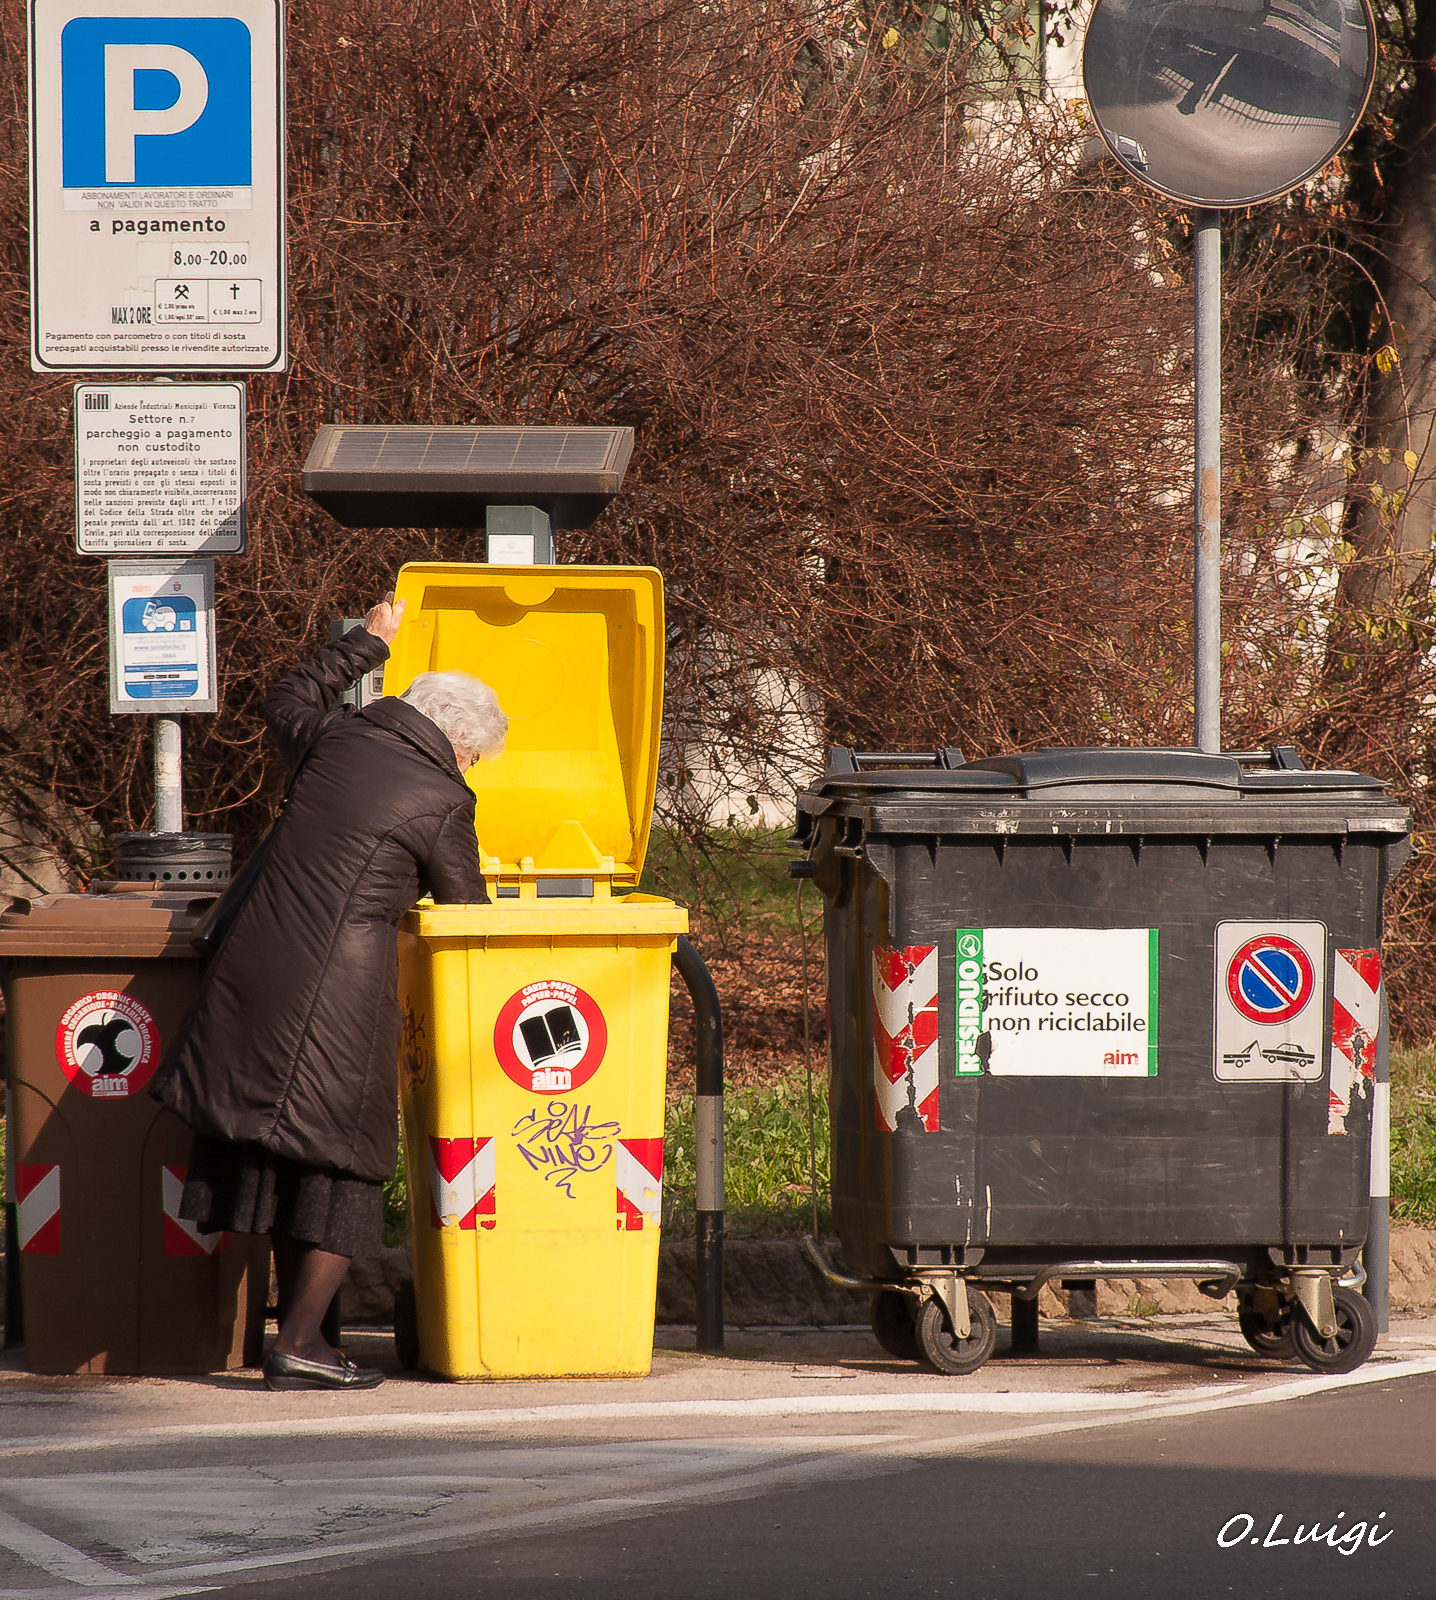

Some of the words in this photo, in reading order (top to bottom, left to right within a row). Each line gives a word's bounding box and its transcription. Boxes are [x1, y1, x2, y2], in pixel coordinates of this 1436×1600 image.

[104, 44, 208, 182] P
[82, 192, 137, 200] ABBONAMENTI
[139, 192, 187, 200] LAVORATORI
[189, 192, 195, 200] E
[197, 191, 233, 199] ORDINARI
[189, 200, 218, 208] TRATTO
[90, 220, 101, 232] a
[112, 216, 226, 235] pagamento
[112, 307, 128, 324] MAX
[130, 307, 134, 324] 2
[137, 307, 152, 324] ORE
[45, 332, 93, 342] Pagamento
[114, 333, 162, 341] parcometro
[190, 332, 211, 340] titoli
[213, 332, 221, 340] di
[45, 344, 87, 354] prepagati
[89, 344, 139, 354] acquistabili
[141, 345, 170, 353] presso
[172, 344, 180, 352] le
[182, 344, 220, 352] rivendite
[222, 344, 271, 352] autorizzate.
[129, 414, 173, 424] Settore
[86, 429, 151, 440] parcheggio
[167, 429, 232, 440] pagamento
[118, 444, 139, 452] non
[145, 442, 201, 452] custodito
[89, 458, 127, 467] proprietari
[131, 458, 149, 467] degli
[151, 458, 190, 466] autoveicoli
[194, 458, 207, 466] che
[210, 458, 237, 466] sostano
[134, 469, 169, 478] prepagato
[105, 479, 132, 487] previsti
[161, 479, 170, 487] gli
[200, 479, 225, 487] esposti
[83, 488, 102, 496] modo
[119, 488, 162, 496] chiaramente
[84, 498, 102, 506] nelle
[105, 498, 134, 506] sanzioni
[137, 498, 165, 507] previste
[170, 498, 188, 507] dagli
[212, 498, 215, 506] 7
[225, 498, 237, 506] 157
[84, 508, 96, 516] del
[100, 508, 122, 516] Codice
[128, 508, 145, 516] della
[151, 508, 174, 516] Strada
[178, 508, 195, 516] oltre
[201, 508, 214, 516] che
[219, 508, 237, 516] nella
[84, 519, 108, 527] penale
[111, 519, 138, 527] prevista
[179, 518, 196, 526] 1382
[110, 529, 123, 538] pari
[143, 529, 195, 538] corresponsione
[114, 539, 152, 547] giornaliera
[132, 584, 152, 593] aim
[989, 961, 1039, 981] Solo
[988, 986, 1059, 1007] rifiuto
[1065, 991, 1130, 1007] secco
[958, 959, 983, 1073] RESIDUO
[988, 1016, 1031, 1031] non
[1038, 1012, 1147, 1032] riciclabile
[1103, 1049, 1139, 1065] aim
[532, 1067, 572, 1085] aim
[91, 1074, 129, 1091] aim
